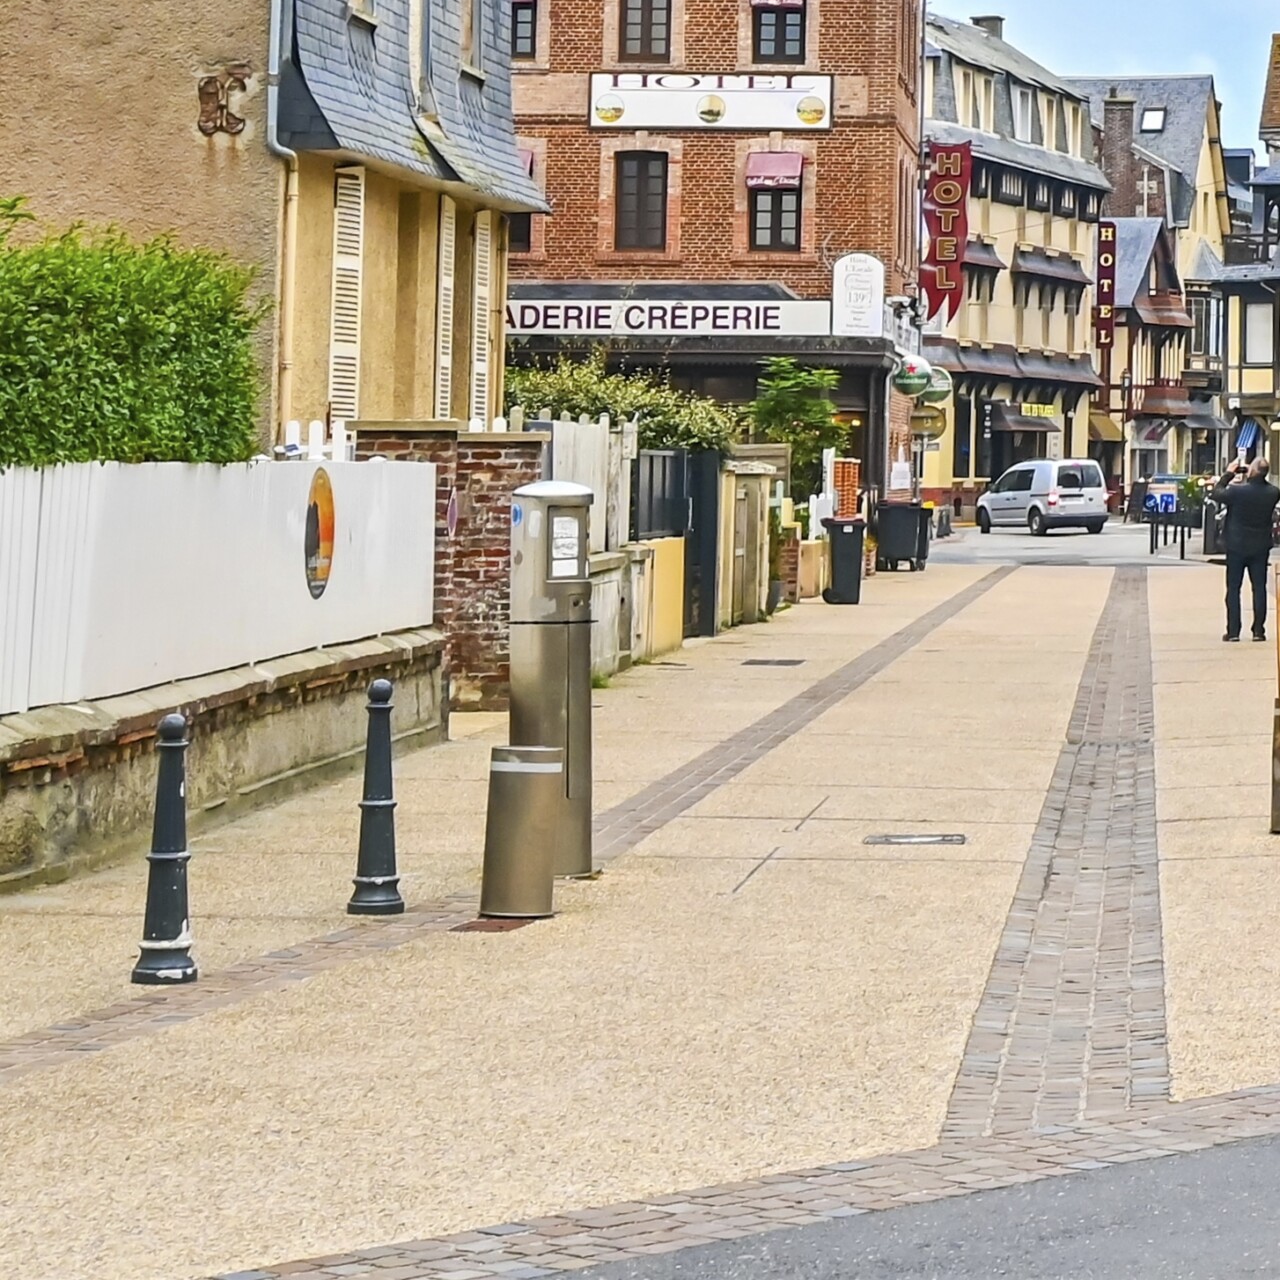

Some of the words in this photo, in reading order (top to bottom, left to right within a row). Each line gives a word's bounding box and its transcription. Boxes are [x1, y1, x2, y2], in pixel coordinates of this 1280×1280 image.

[933, 152, 962, 289] HOTEL
[624, 301, 781, 330] CRÊPERIE
[1099, 227, 1114, 344] HOTEL
